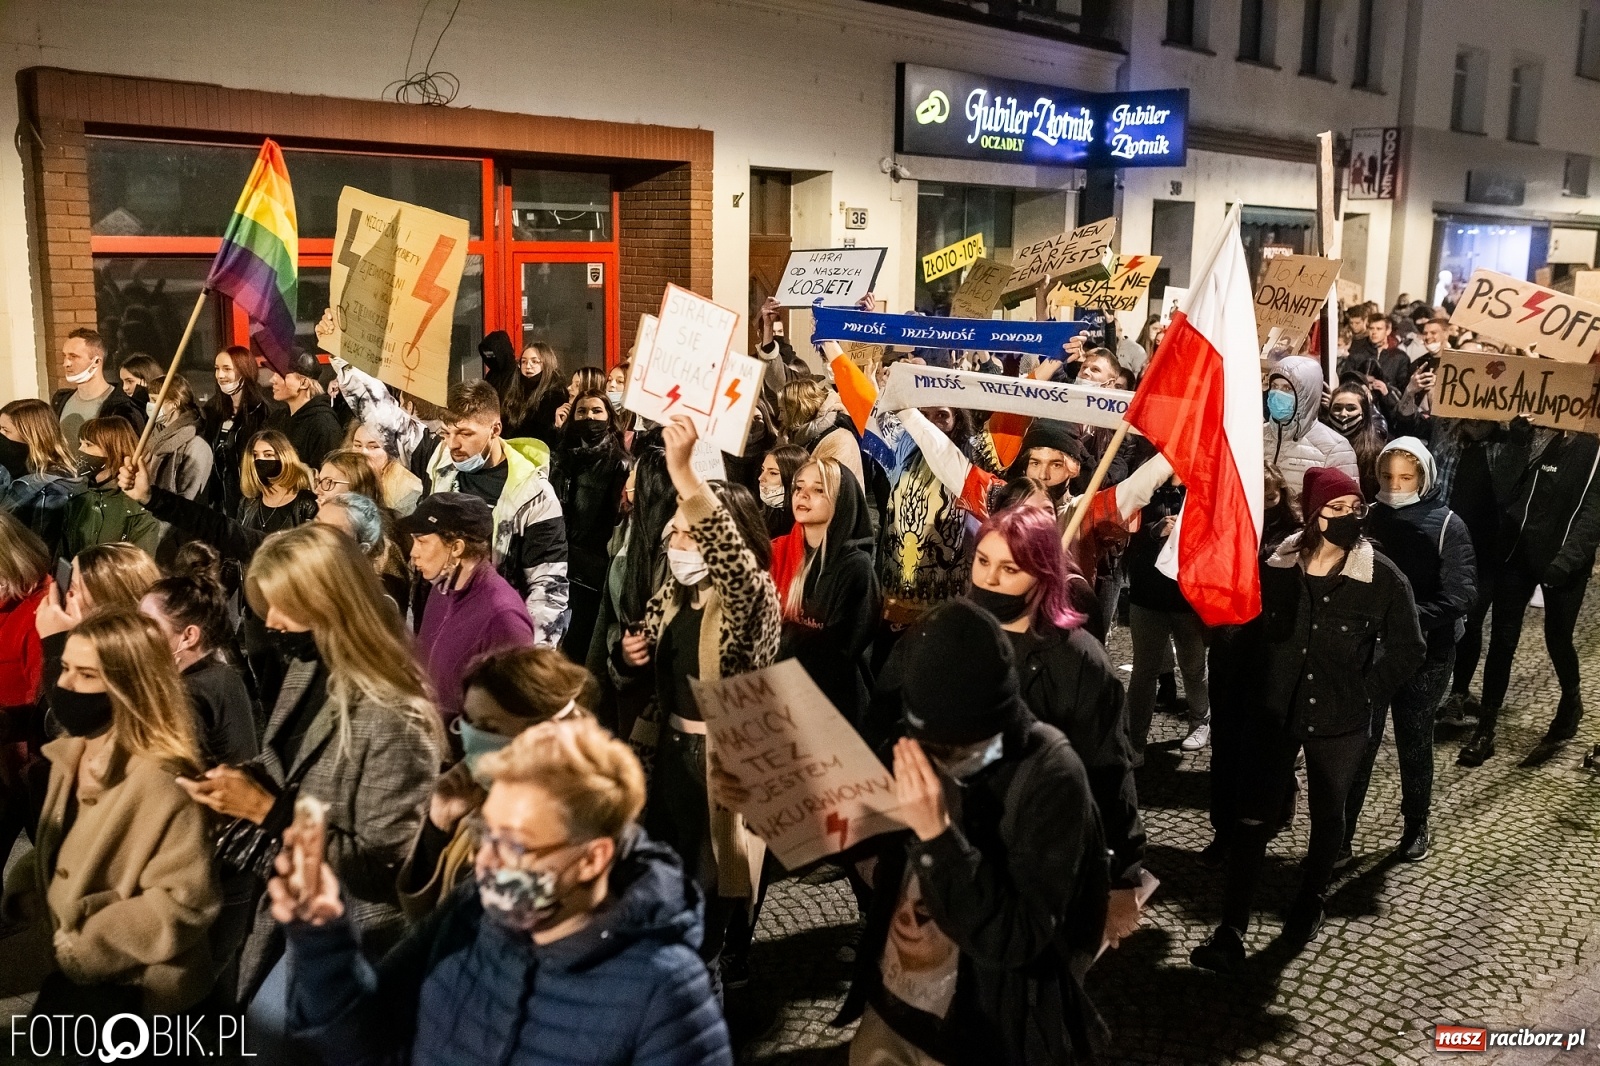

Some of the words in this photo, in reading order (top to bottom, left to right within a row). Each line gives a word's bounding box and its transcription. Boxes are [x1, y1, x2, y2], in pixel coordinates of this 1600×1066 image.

[965, 88, 1032, 143] Jubiler
[1032, 97, 1094, 146] Złotnik
[1111, 104, 1170, 133] Jubiler
[981, 135, 1024, 152] OCZADŁY
[1111, 134, 1170, 159] Złotnik
[852, 211, 866, 225] 36
[809, 252, 843, 263] WARA
[1019, 235, 1065, 259] REAL
[1070, 223, 1107, 241] MEN
[1029, 241, 1078, 267] ARE
[790, 267, 806, 276] OD
[813, 267, 862, 276] NASZYCH
[925, 249, 957, 278] ZŁOTO
[959, 238, 983, 261] -10%
[1006, 245, 1108, 287] FEMINISTS
[1273, 259, 1293, 281] To
[788, 279, 854, 296] KOBIET!
[1120, 272, 1151, 291] NIE
[670, 295, 730, 330] STRACH
[1079, 293, 1138, 312] JARUSIA
[1256, 285, 1324, 318] DRANAT
[1467, 278, 1519, 319] PiS
[1540, 304, 1600, 347] OFF
[842, 321, 887, 335] MIŁOŚĆ
[901, 326, 976, 341] TRZEŹWOŚĆ
[652, 347, 716, 390] RUCHAĆ
[914, 374, 966, 390] MIŁOŚĆ
[977, 381, 1069, 403] TRZEŹWOŚĆ
[1086, 395, 1129, 414] POKO
[1439, 364, 1475, 407] PiS
[714, 676, 776, 715] MAM
[714, 705, 797, 752] MACICY
[752, 755, 843, 804] JESTEM
